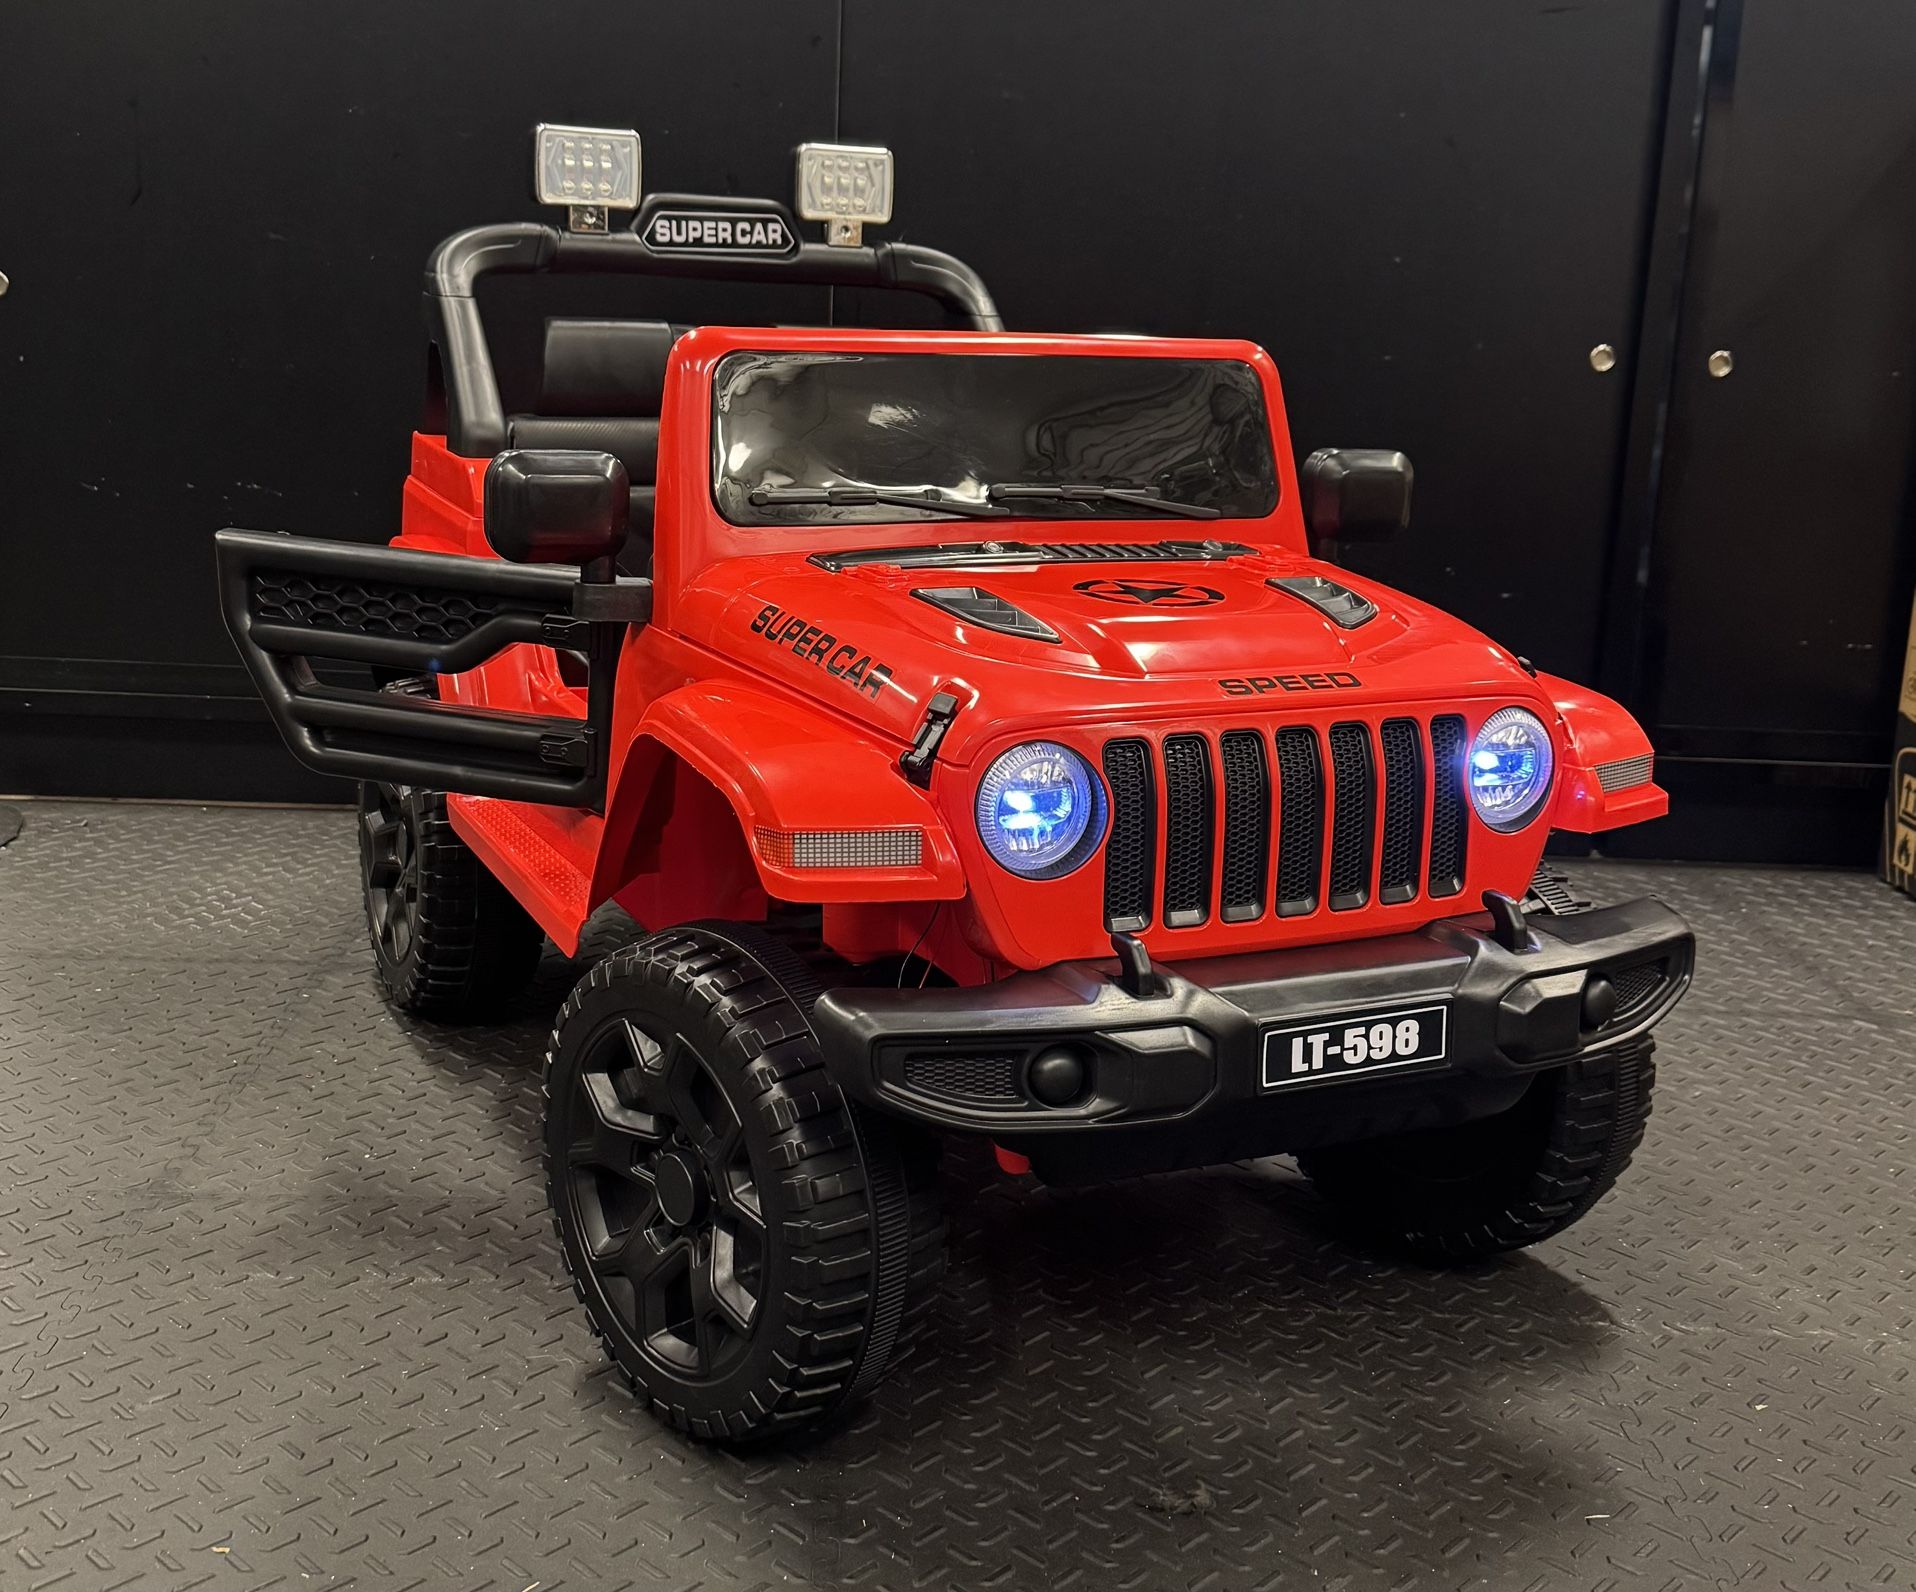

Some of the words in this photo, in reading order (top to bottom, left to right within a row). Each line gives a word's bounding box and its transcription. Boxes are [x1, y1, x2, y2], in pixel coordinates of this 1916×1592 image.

[655, 219, 732, 243] SUPER
[736, 221, 782, 245] CAR
[751, 605, 837, 666] SUPER
[826, 645, 893, 699] CAR
[1218, 672, 1361, 696] SPEED
[1291, 1019, 1420, 1073] LT-598
